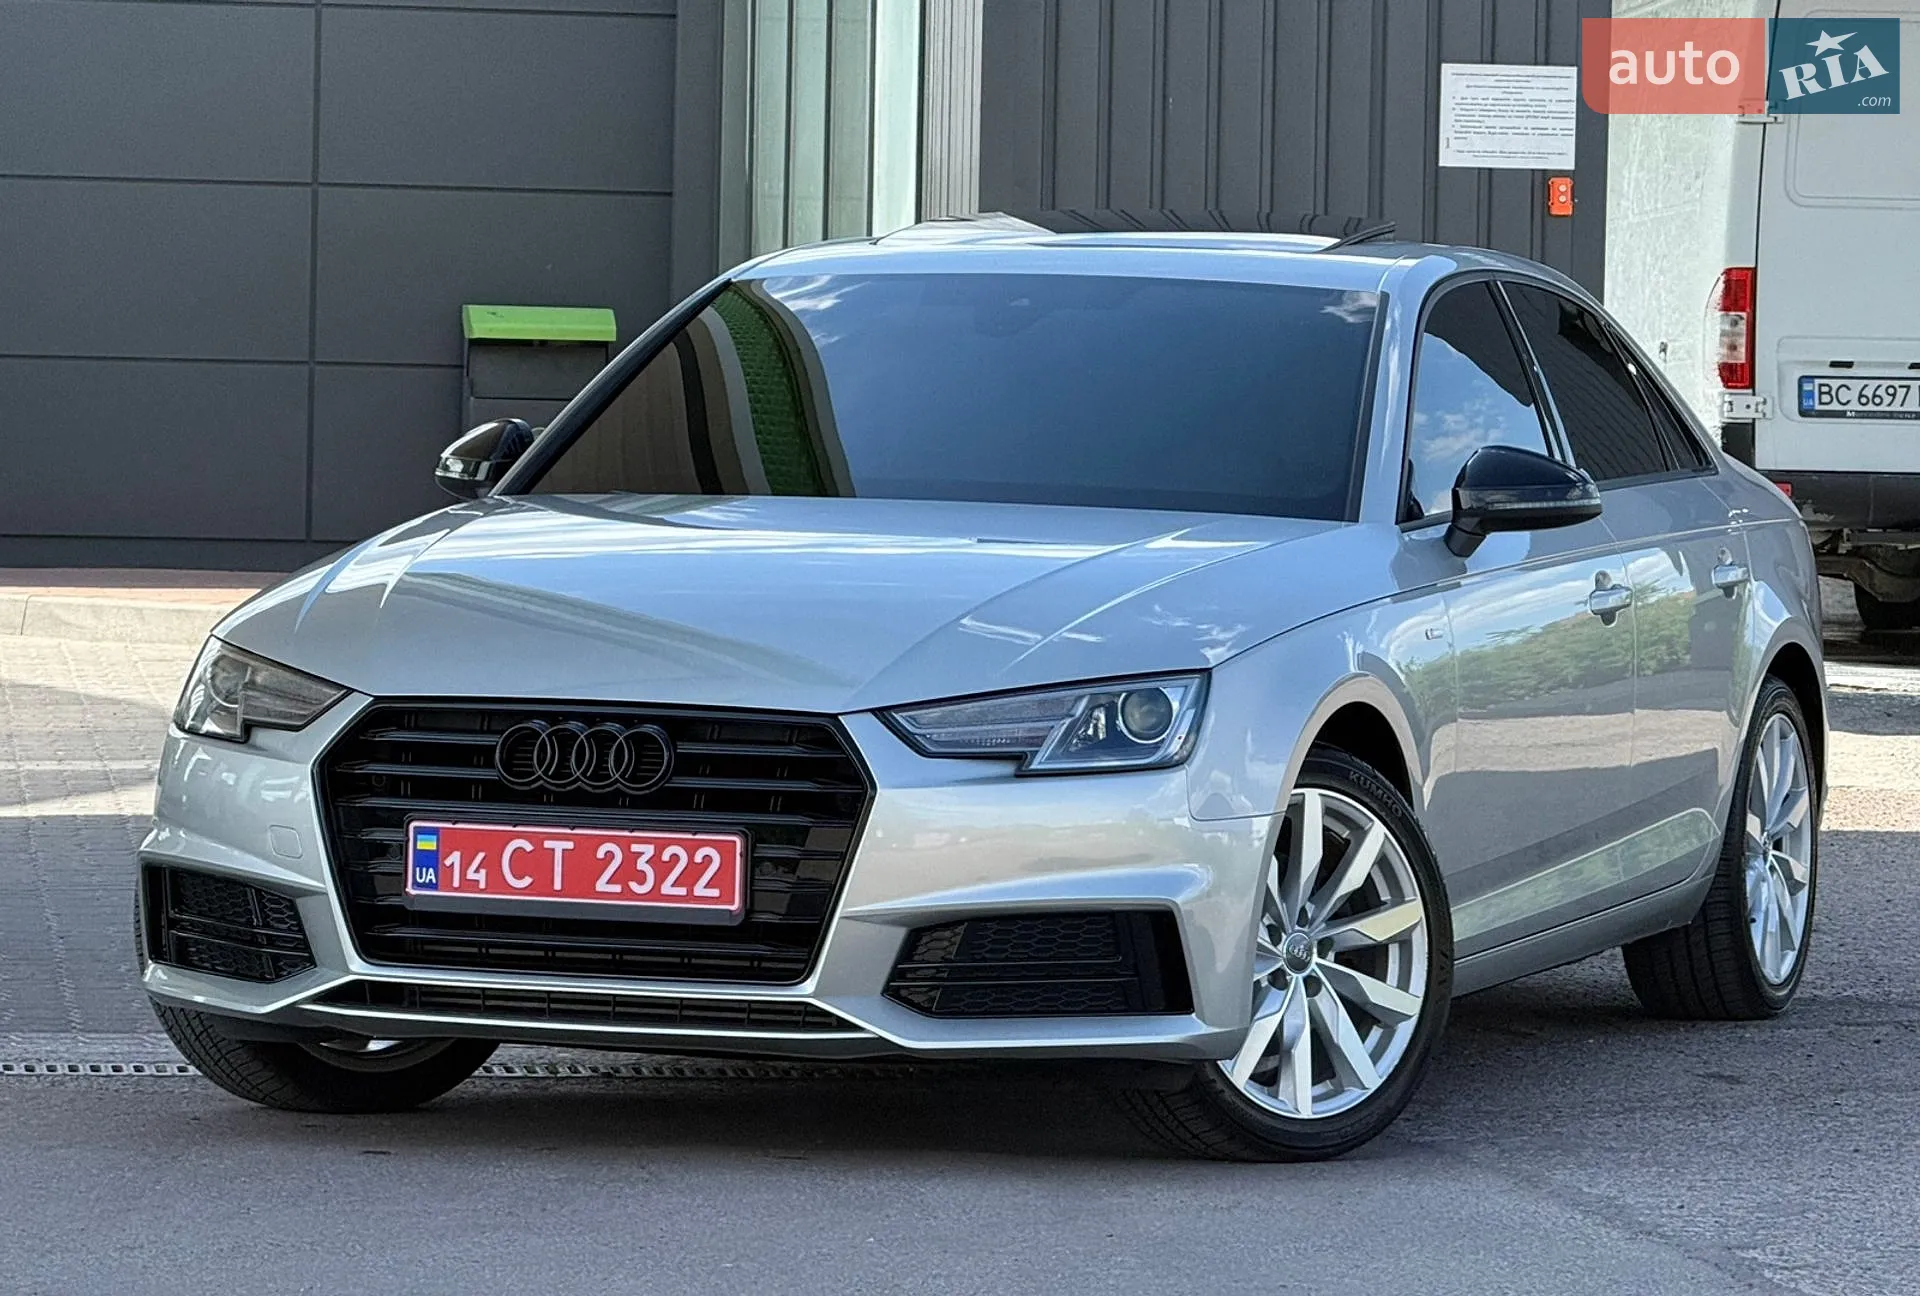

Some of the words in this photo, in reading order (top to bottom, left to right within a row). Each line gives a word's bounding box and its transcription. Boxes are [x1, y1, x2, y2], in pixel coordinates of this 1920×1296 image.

[1818, 383, 1851, 406] BC
[1857, 384, 1912, 407] 6697
[1348, 770, 1403, 818] KUMHO
[415, 866, 437, 884] UA
[444, 850, 487, 890] 14
[501, 838, 575, 891] CT
[595, 842, 721, 897] 2322
